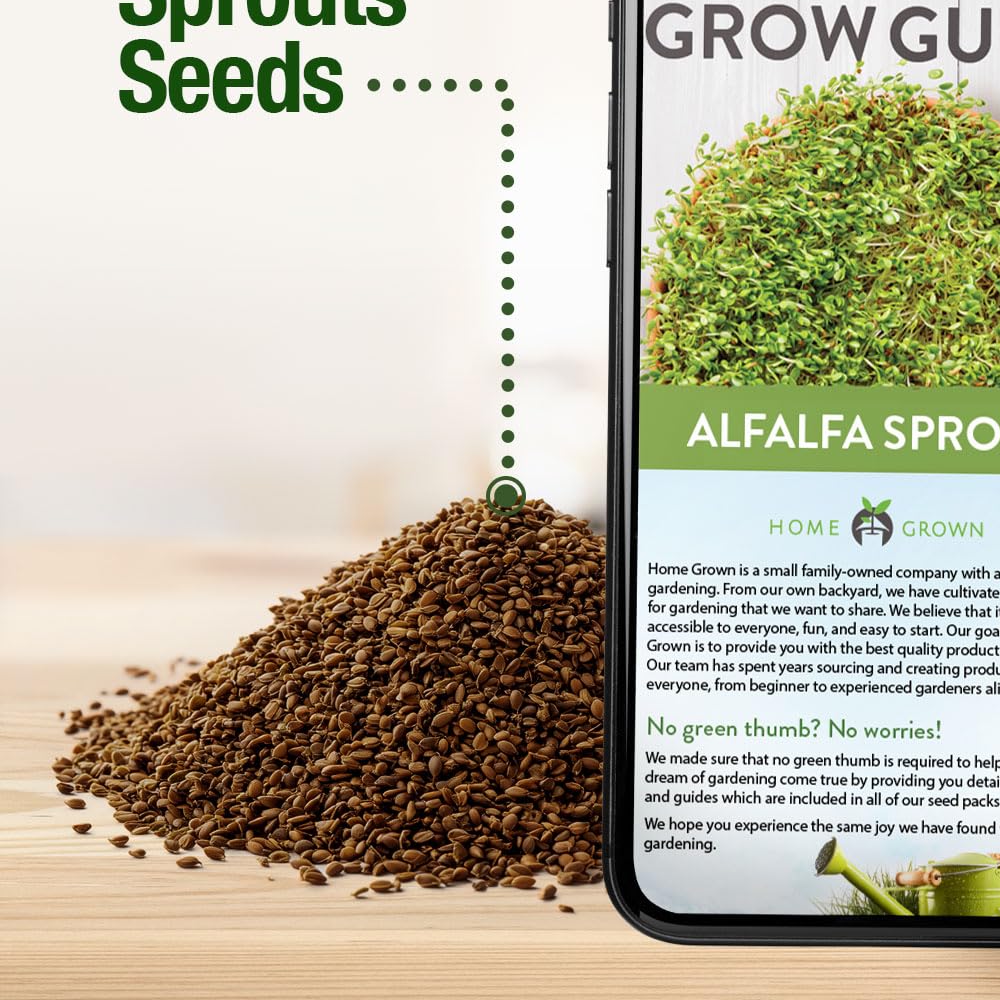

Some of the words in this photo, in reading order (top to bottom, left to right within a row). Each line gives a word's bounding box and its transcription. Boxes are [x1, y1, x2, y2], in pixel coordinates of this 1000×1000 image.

[646, 3, 876, 63] GROW
[687, 413, 873, 449] ALFALFA
[770, 520, 839, 535] HOME
[902, 521, 983, 536] GROWN
[648, 563, 689, 575] Home
[691, 563, 736, 575] Grown
[739, 564, 750, 576] is
[752, 567, 760, 576] a
[763, 563, 798, 576] small
[801, 564, 893, 580] family-owned
[895, 569, 958, 582] company
[961, 566, 991, 579] with
[647, 581, 720, 598] gardening.
[723, 583, 757, 595] From
[759, 587, 784, 595] our
[785, 587, 816, 596] own
[818, 583, 883, 600] backyard,
[885, 588, 906, 597] we
[908, 584, 941, 597] have
[647, 600, 667, 613] for
[669, 600, 738, 617] gardening
[740, 601, 769, 614] that
[770, 606, 791, 615] we
[793, 605, 828, 615] want
[830, 605, 845, 615] to
[847, 603, 887, 616] share.
[888, 604, 911, 616] We
[913, 604, 962, 617] believe
[964, 604, 992, 617] that
[647, 620, 714, 633] accessible
[716, 622, 732, 633] to
[734, 625, 800, 637] everyone,
[802, 621, 828, 636] fun,
[831, 622, 857, 635] and
[859, 626, 890, 638] easy
[892, 625, 907, 635] to
[910, 625, 943, 636] start.
[946, 624, 972, 636] Our
[646, 639, 691, 652] Grown
[695, 640, 705, 652] is
[707, 641, 722, 652] to
[725, 640, 777, 656] provide
[779, 645, 804, 656] you
[807, 641, 837, 654] with
[839, 641, 863, 654] the
[865, 641, 894, 655] best
[897, 642, 944, 659] quality
[647, 716, 677, 735] No
[682, 725, 738, 743] green
[744, 718, 821, 737] thumb?
[829, 719, 858, 738] No
[863, 720, 941, 739] worries!
[645, 752, 667, 764] We
[669, 751, 708, 764] made
[710, 756, 739, 765] sure
[741, 752, 769, 765] that
[772, 757, 791, 765] no
[793, 757, 832, 769] green
[834, 753, 881, 767] thumb
[884, 755, 894, 767] is
[897, 755, 954, 770] required
[956, 757, 971, 768] to
[644, 789, 670, 802] and
[673, 790, 719, 806] guides
[721, 790, 762, 804] which
[764, 795, 786, 804] are
[789, 792, 847, 805] included
[850, 793, 863, 805] in
[865, 792, 882, 805] all
[884, 793, 900, 805] of
[901, 797, 925, 806] our
[927, 794, 959, 806] seed
[962, 794, 1000, 810] packs
[644, 817, 666, 830] We
[668, 817, 704, 833] hope
[705, 822, 731, 834] you
[734, 819, 809, 834] experience
[810, 819, 834, 832] the
[836, 824, 872, 833] same
[873, 821, 896, 836] joy
[898, 824, 919, 833] we
[921, 820, 954, 834] have
[956, 821, 997, 834] found
[643, 836, 717, 853] gardening.
